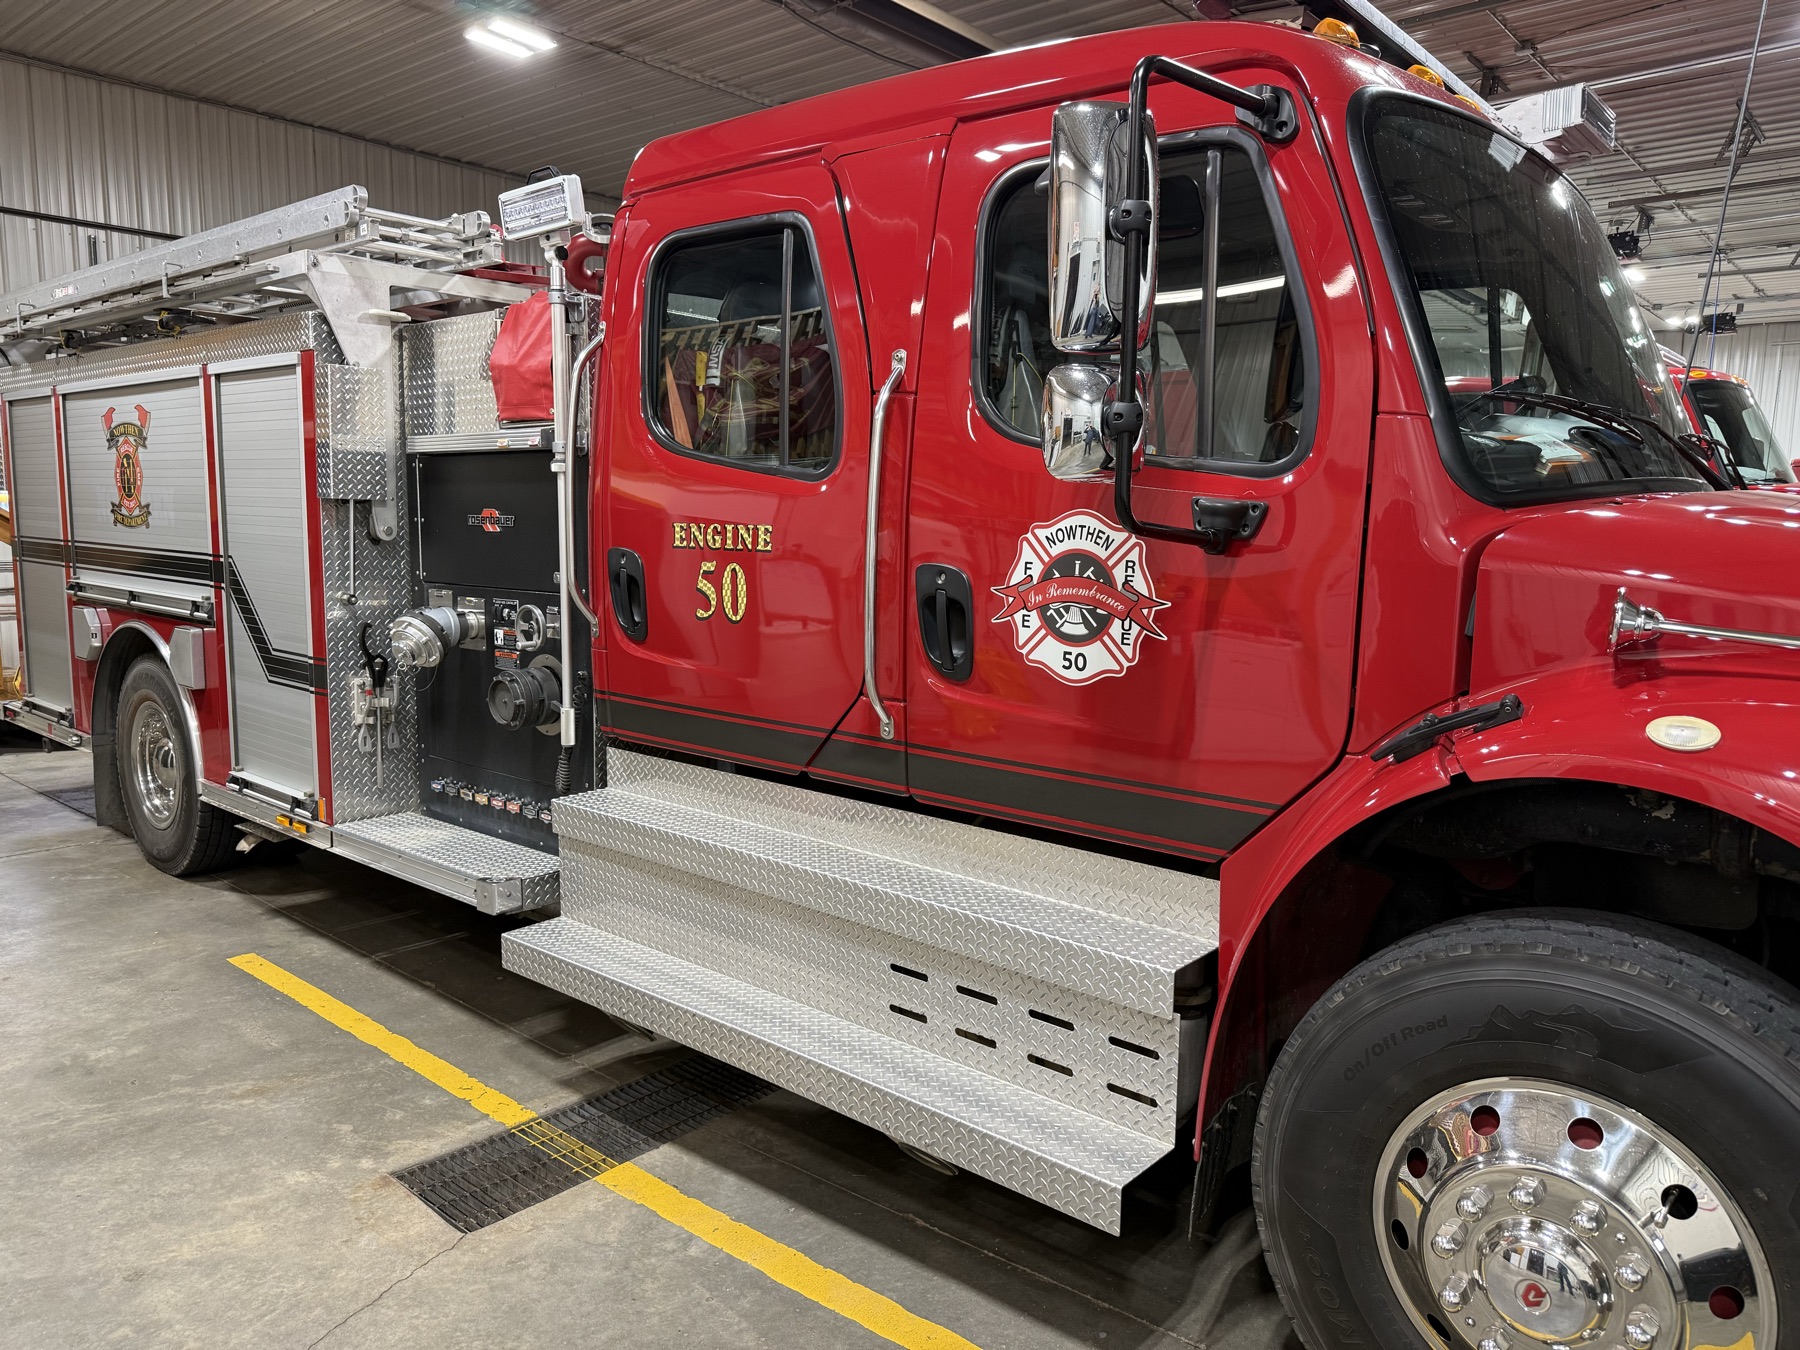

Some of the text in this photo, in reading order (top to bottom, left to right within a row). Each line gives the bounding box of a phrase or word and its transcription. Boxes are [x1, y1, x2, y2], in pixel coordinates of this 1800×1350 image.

[709, 336, 727, 368] MSA
[113, 424, 139, 437] NOWTHEN
[114, 512, 123, 523] FIRE
[468, 511, 515, 526] rosenbauer
[672, 522, 773, 553] ENGINE
[1045, 524, 1115, 552] NOWTHEN
[695, 560, 747, 624] 50
[1021, 561, 1034, 628] FE
[1027, 583, 1126, 612] In Remembrance
[1061, 650, 1087, 672] 50
[1343, 1013, 1449, 1082] On/Off Road
